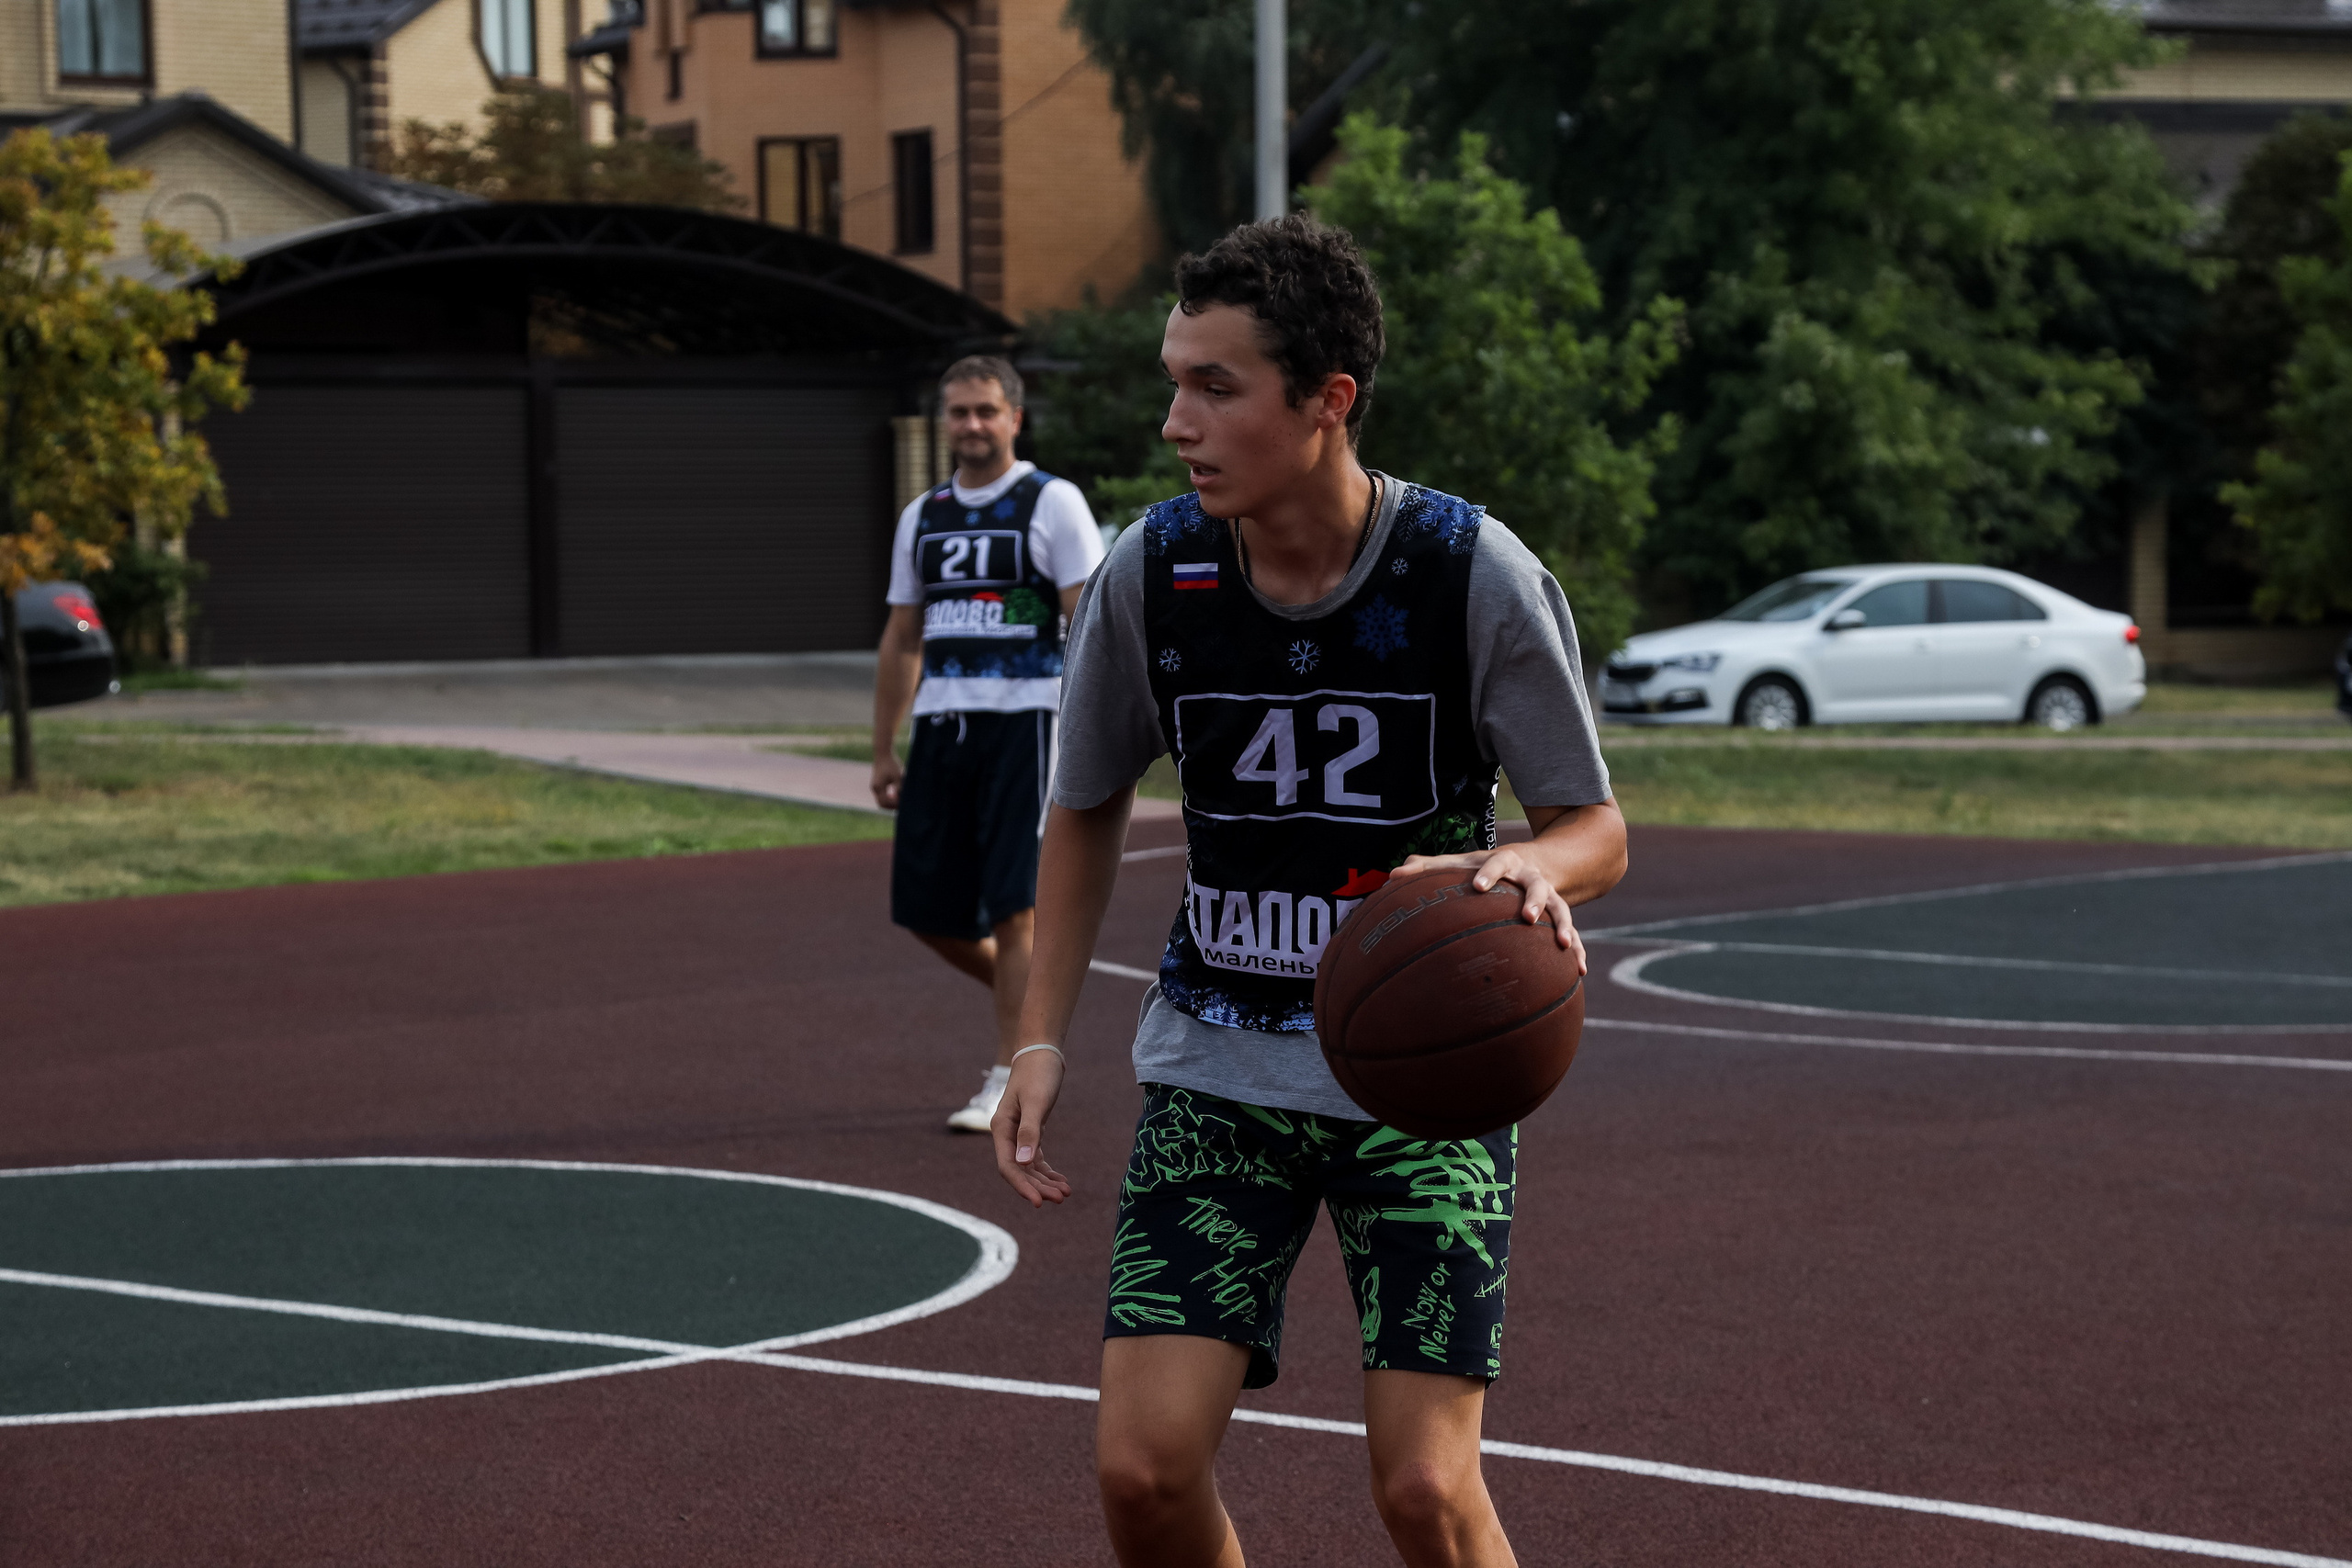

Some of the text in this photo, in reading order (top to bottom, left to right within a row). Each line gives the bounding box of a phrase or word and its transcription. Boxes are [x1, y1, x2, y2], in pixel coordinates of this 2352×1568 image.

[941, 535, 991, 581] 21
[1232, 703, 1382, 809] 42
[1188, 874, 1360, 953] ТАПО
[1204, 947, 1320, 976] малень
